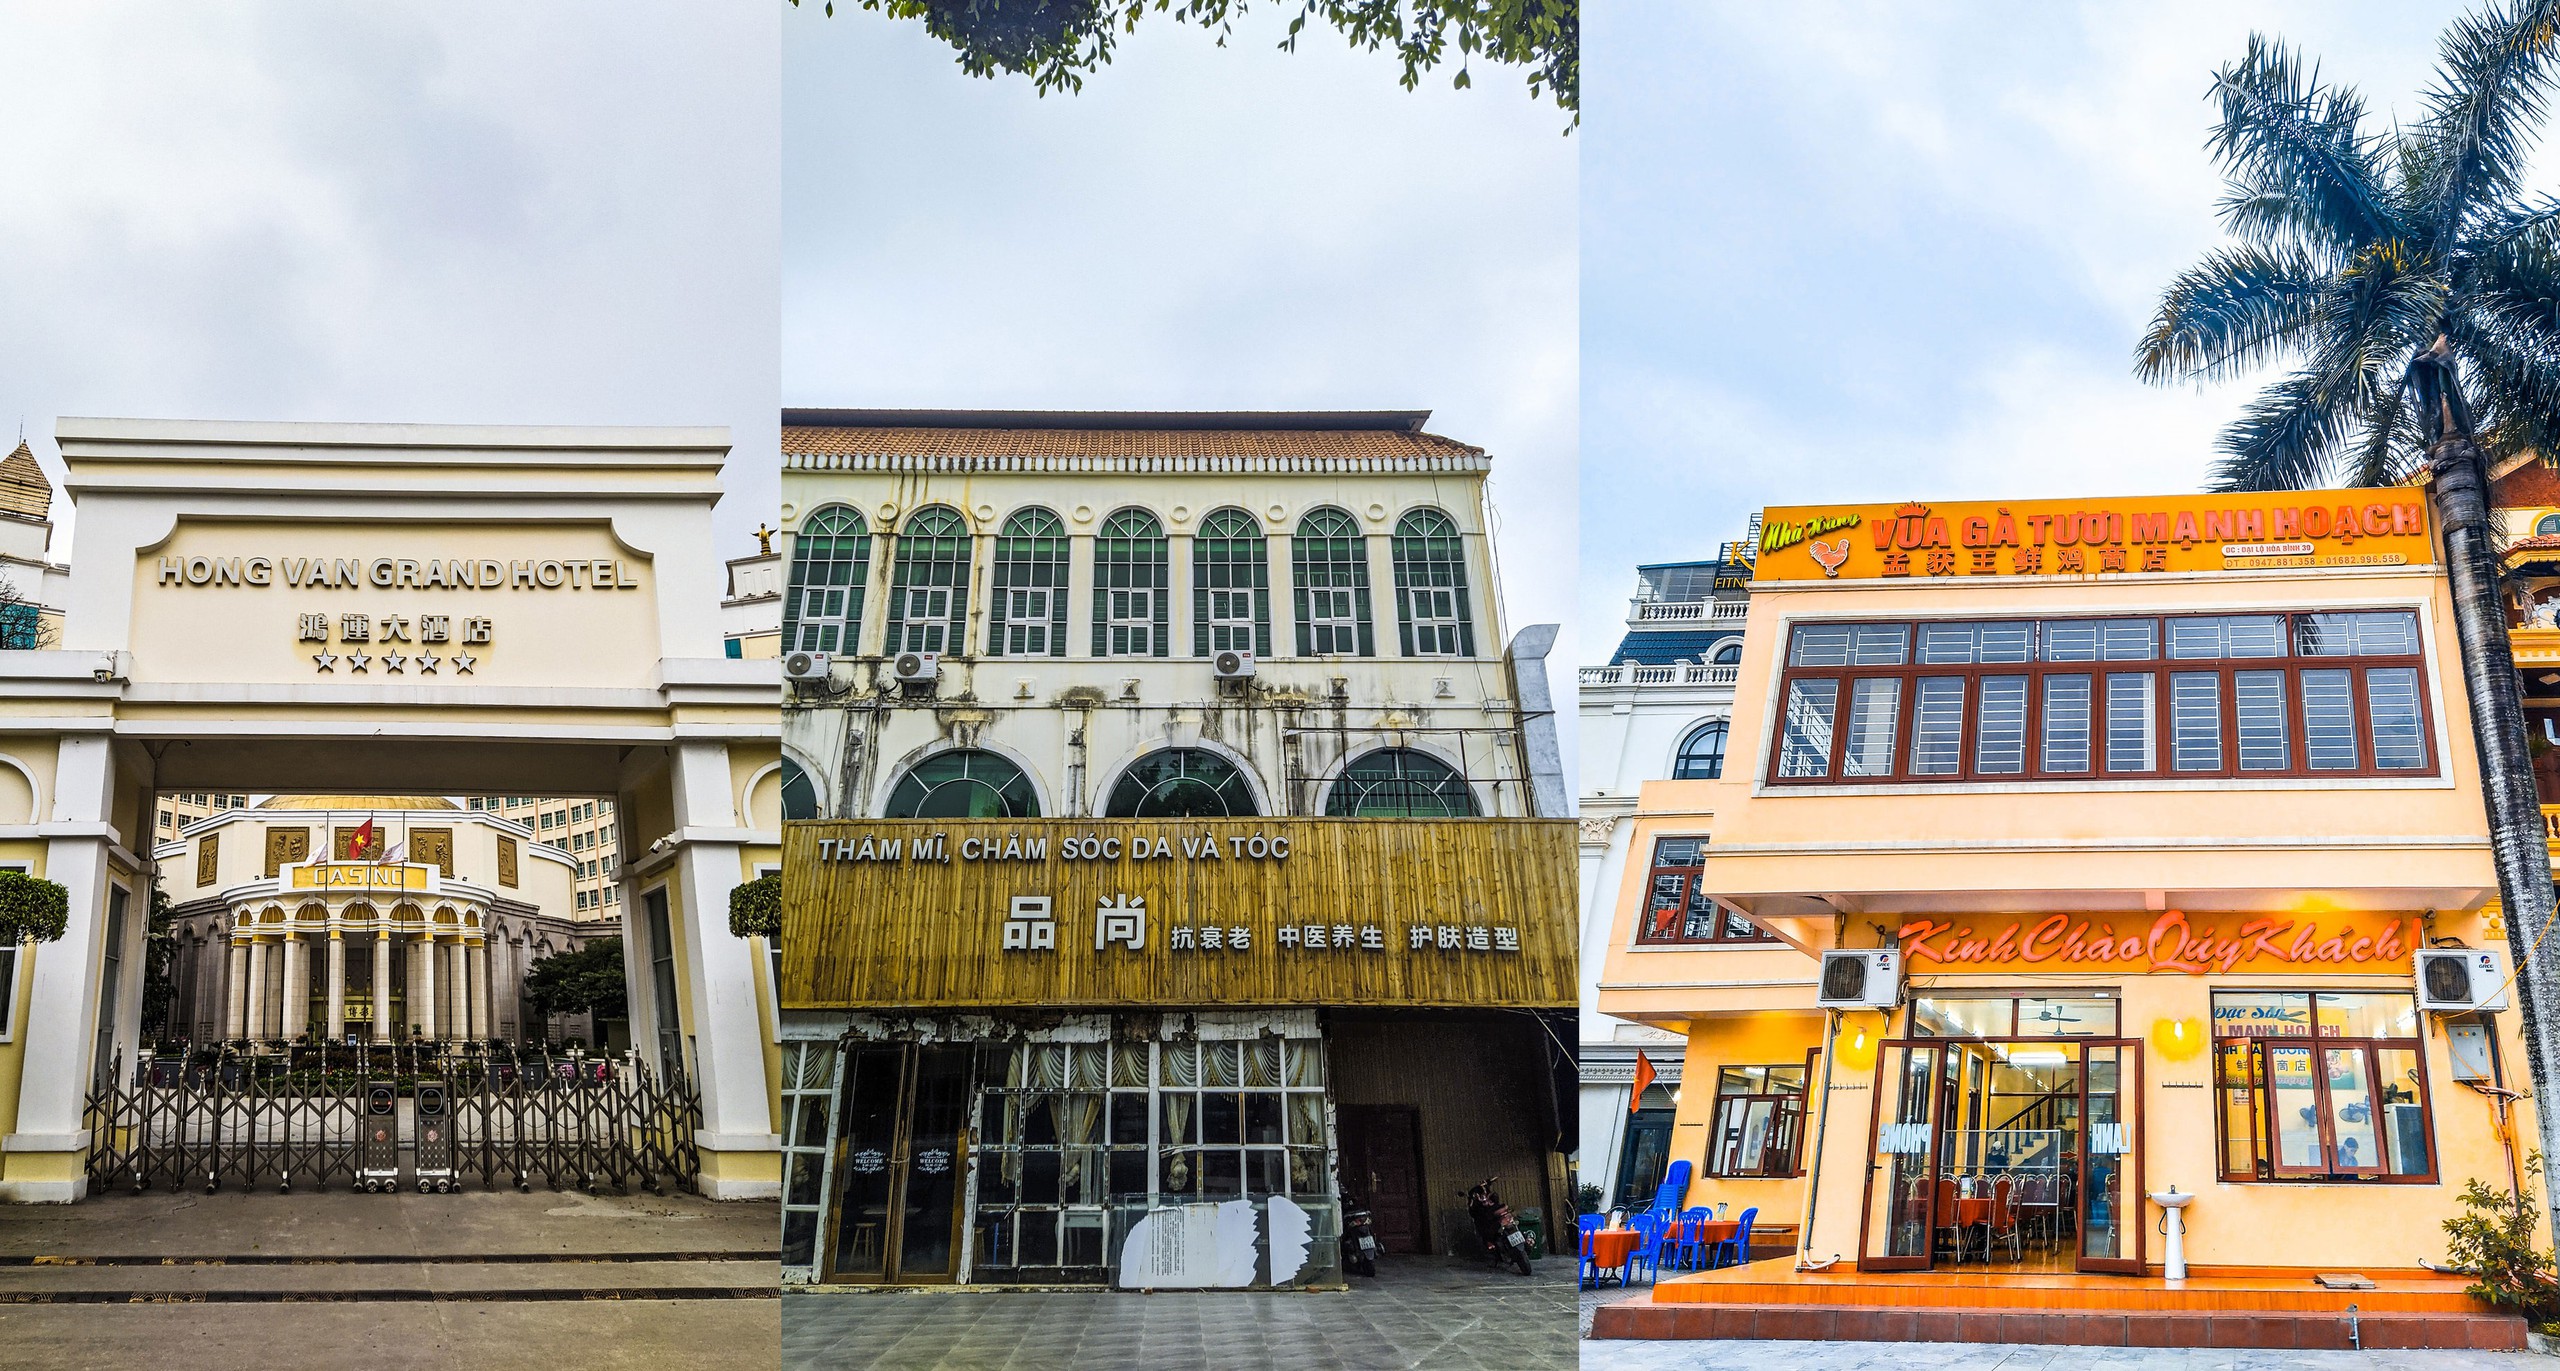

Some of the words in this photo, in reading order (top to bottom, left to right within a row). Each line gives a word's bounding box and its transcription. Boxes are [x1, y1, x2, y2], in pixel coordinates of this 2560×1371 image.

[1760, 521, 1804, 555] Nhà
[1871, 516, 1950, 550] VUA
[1961, 508, 2019, 547] GÀ
[2028, 511, 2122, 546] TƯƠI
[2131, 507, 2265, 550] MẠNH
[2274, 503, 2421, 545] HOẠCH
[2249, 558, 2315, 567] 0947.881.358
[2326, 555, 2400, 565] 01682.996.558
[2283, 544, 2301, 552] BÌNH
[158, 555, 272, 586] HONG
[282, 557, 360, 588] VAN
[369, 558, 505, 590] GRAND
[511, 559, 639, 590] HOTEL
[818, 833, 902, 861] THẨM
[912, 832, 950, 864] MĨ,
[962, 833, 1047, 860] CHĂM
[1061, 832, 1122, 860] SÓC
[1132, 836, 1173, 859] DA
[1182, 832, 1220, 859] VÀ
[1229, 831, 1290, 859] TÓC
[314, 866, 406, 886] CASINO
[1003, 893, 1146, 950] 品尚
[1171, 925, 1252, 950] 抗衰老
[1277, 924, 1384, 949] 中医养生
[1409, 925, 1520, 951] 护肤造型
[1898, 920, 2020, 963] Kính
[2020, 914, 2146, 963] Chào
